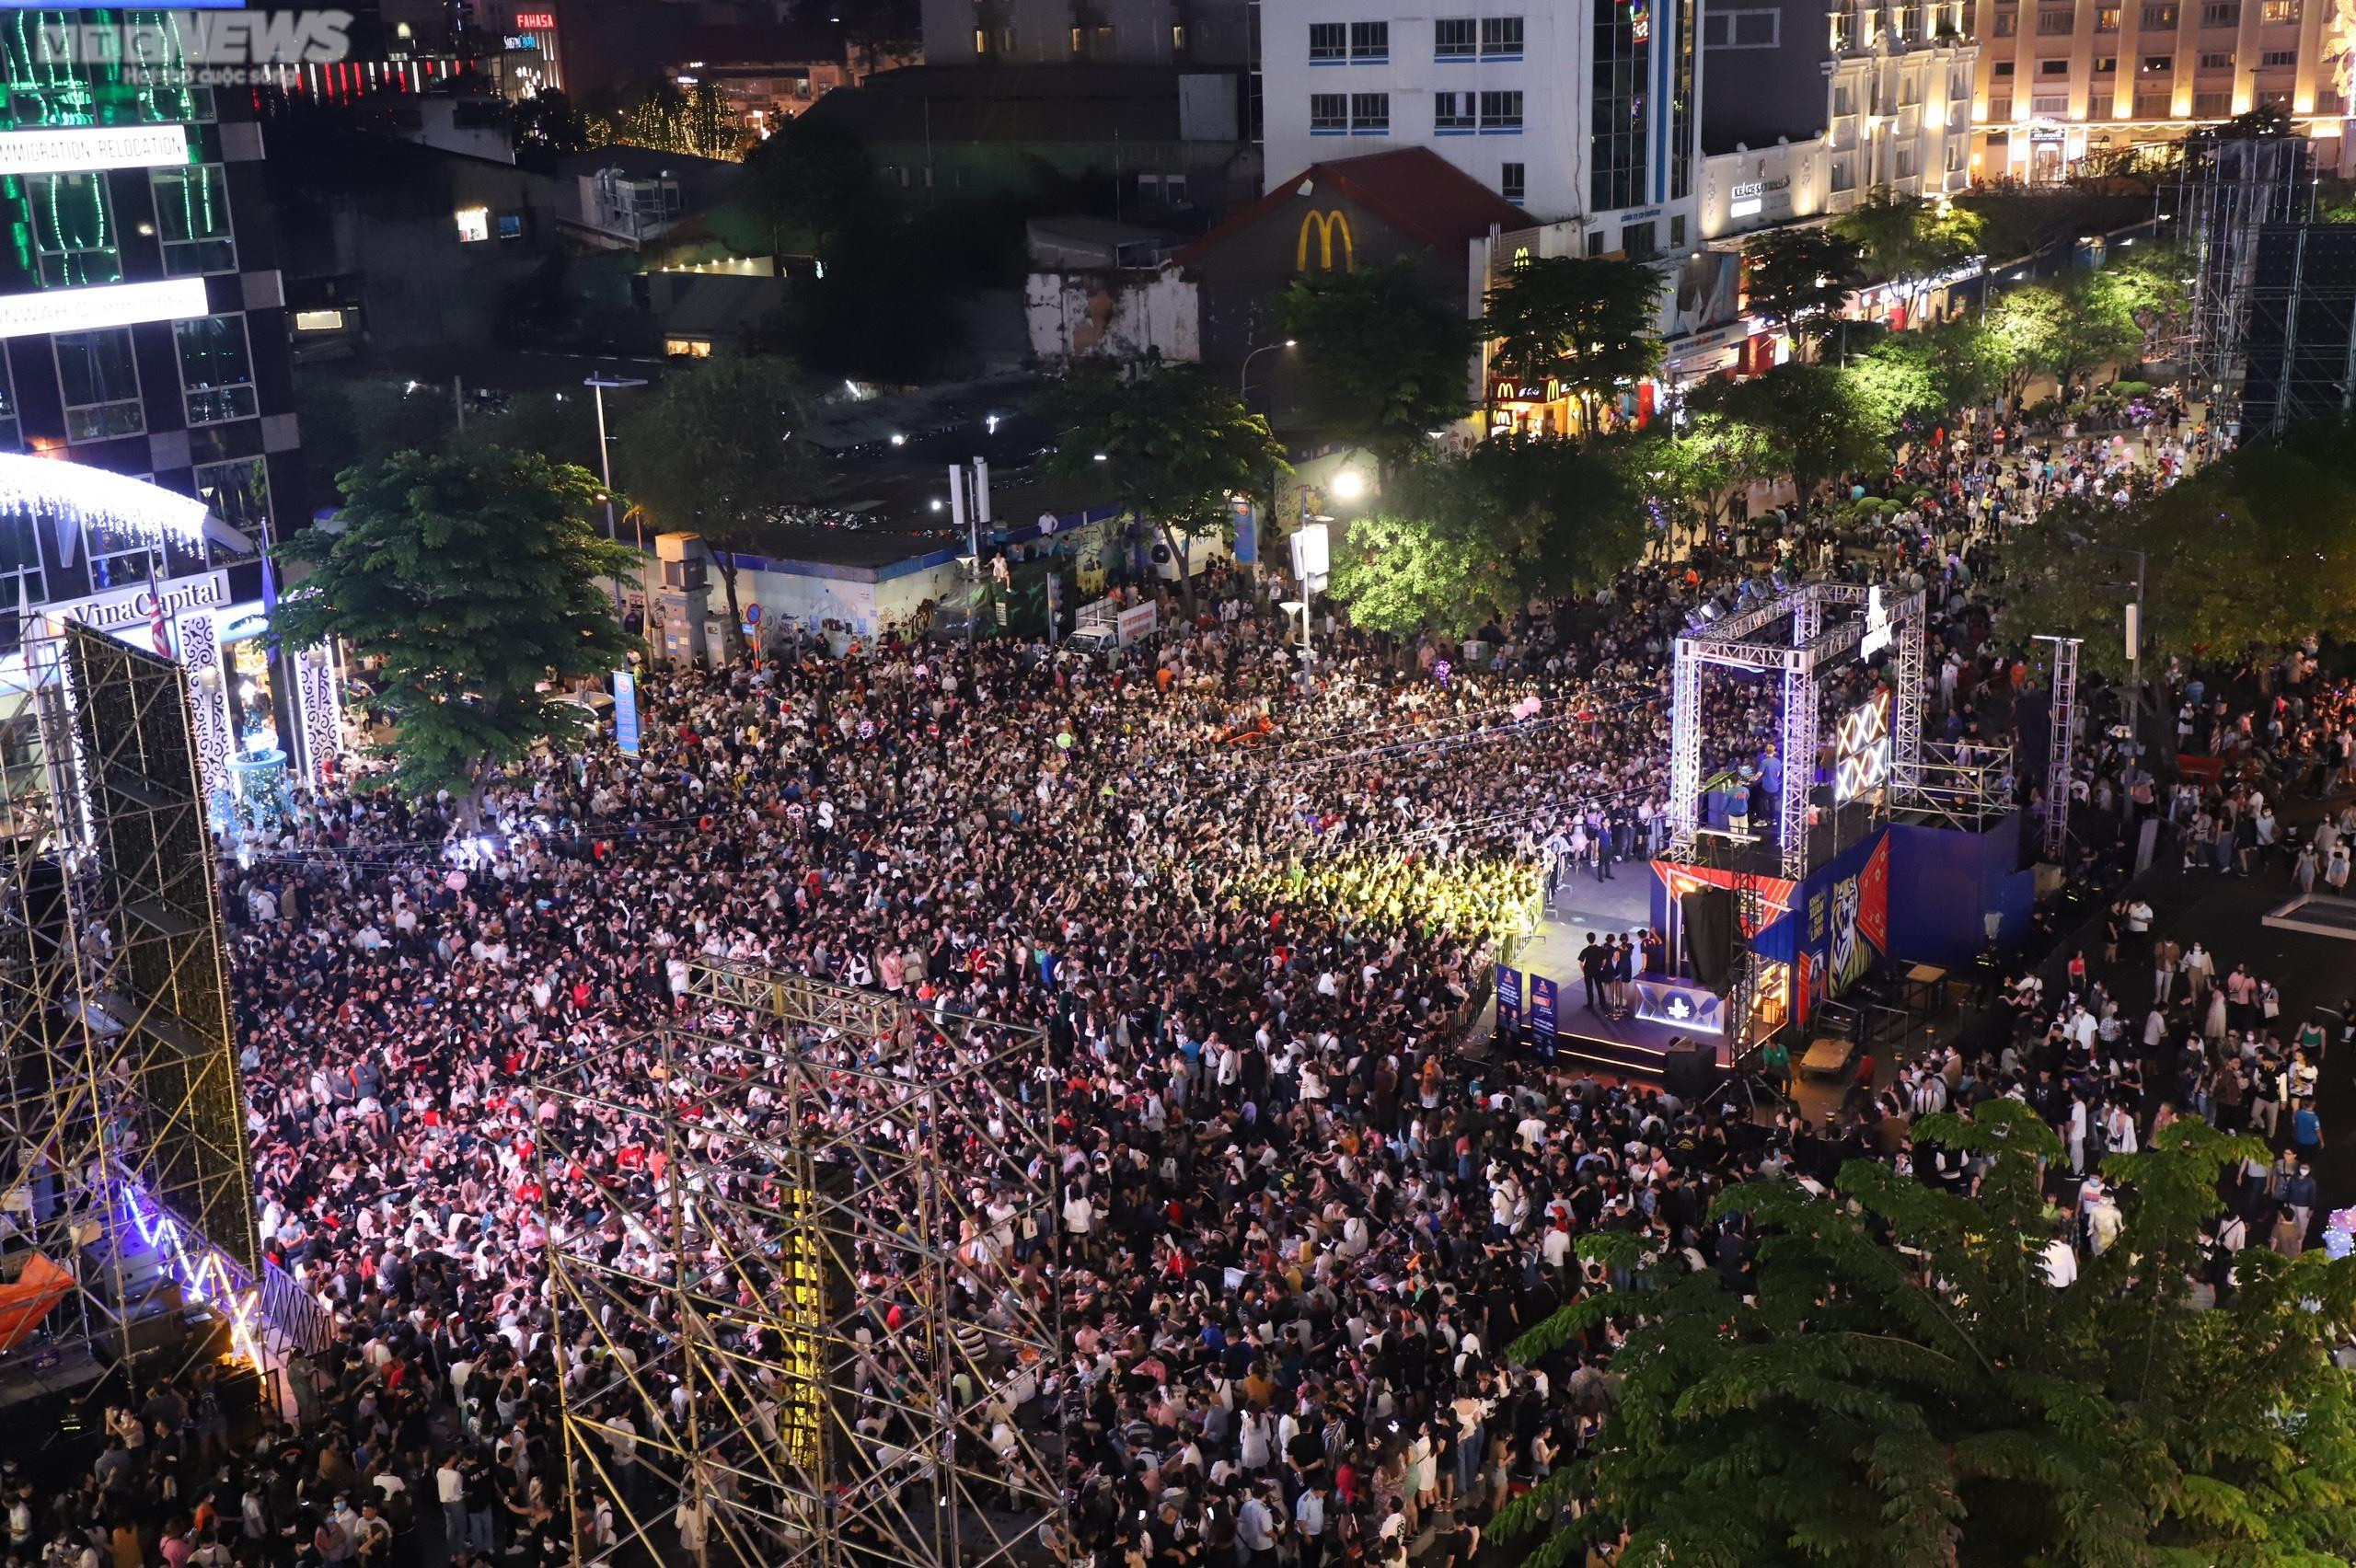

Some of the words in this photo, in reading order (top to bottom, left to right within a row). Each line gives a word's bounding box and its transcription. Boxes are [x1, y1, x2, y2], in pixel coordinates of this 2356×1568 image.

[516, 14, 554, 29] FAHASA
[98, 136, 182, 158] RELOCATION
[72, 575, 223, 627] VinaCapital
